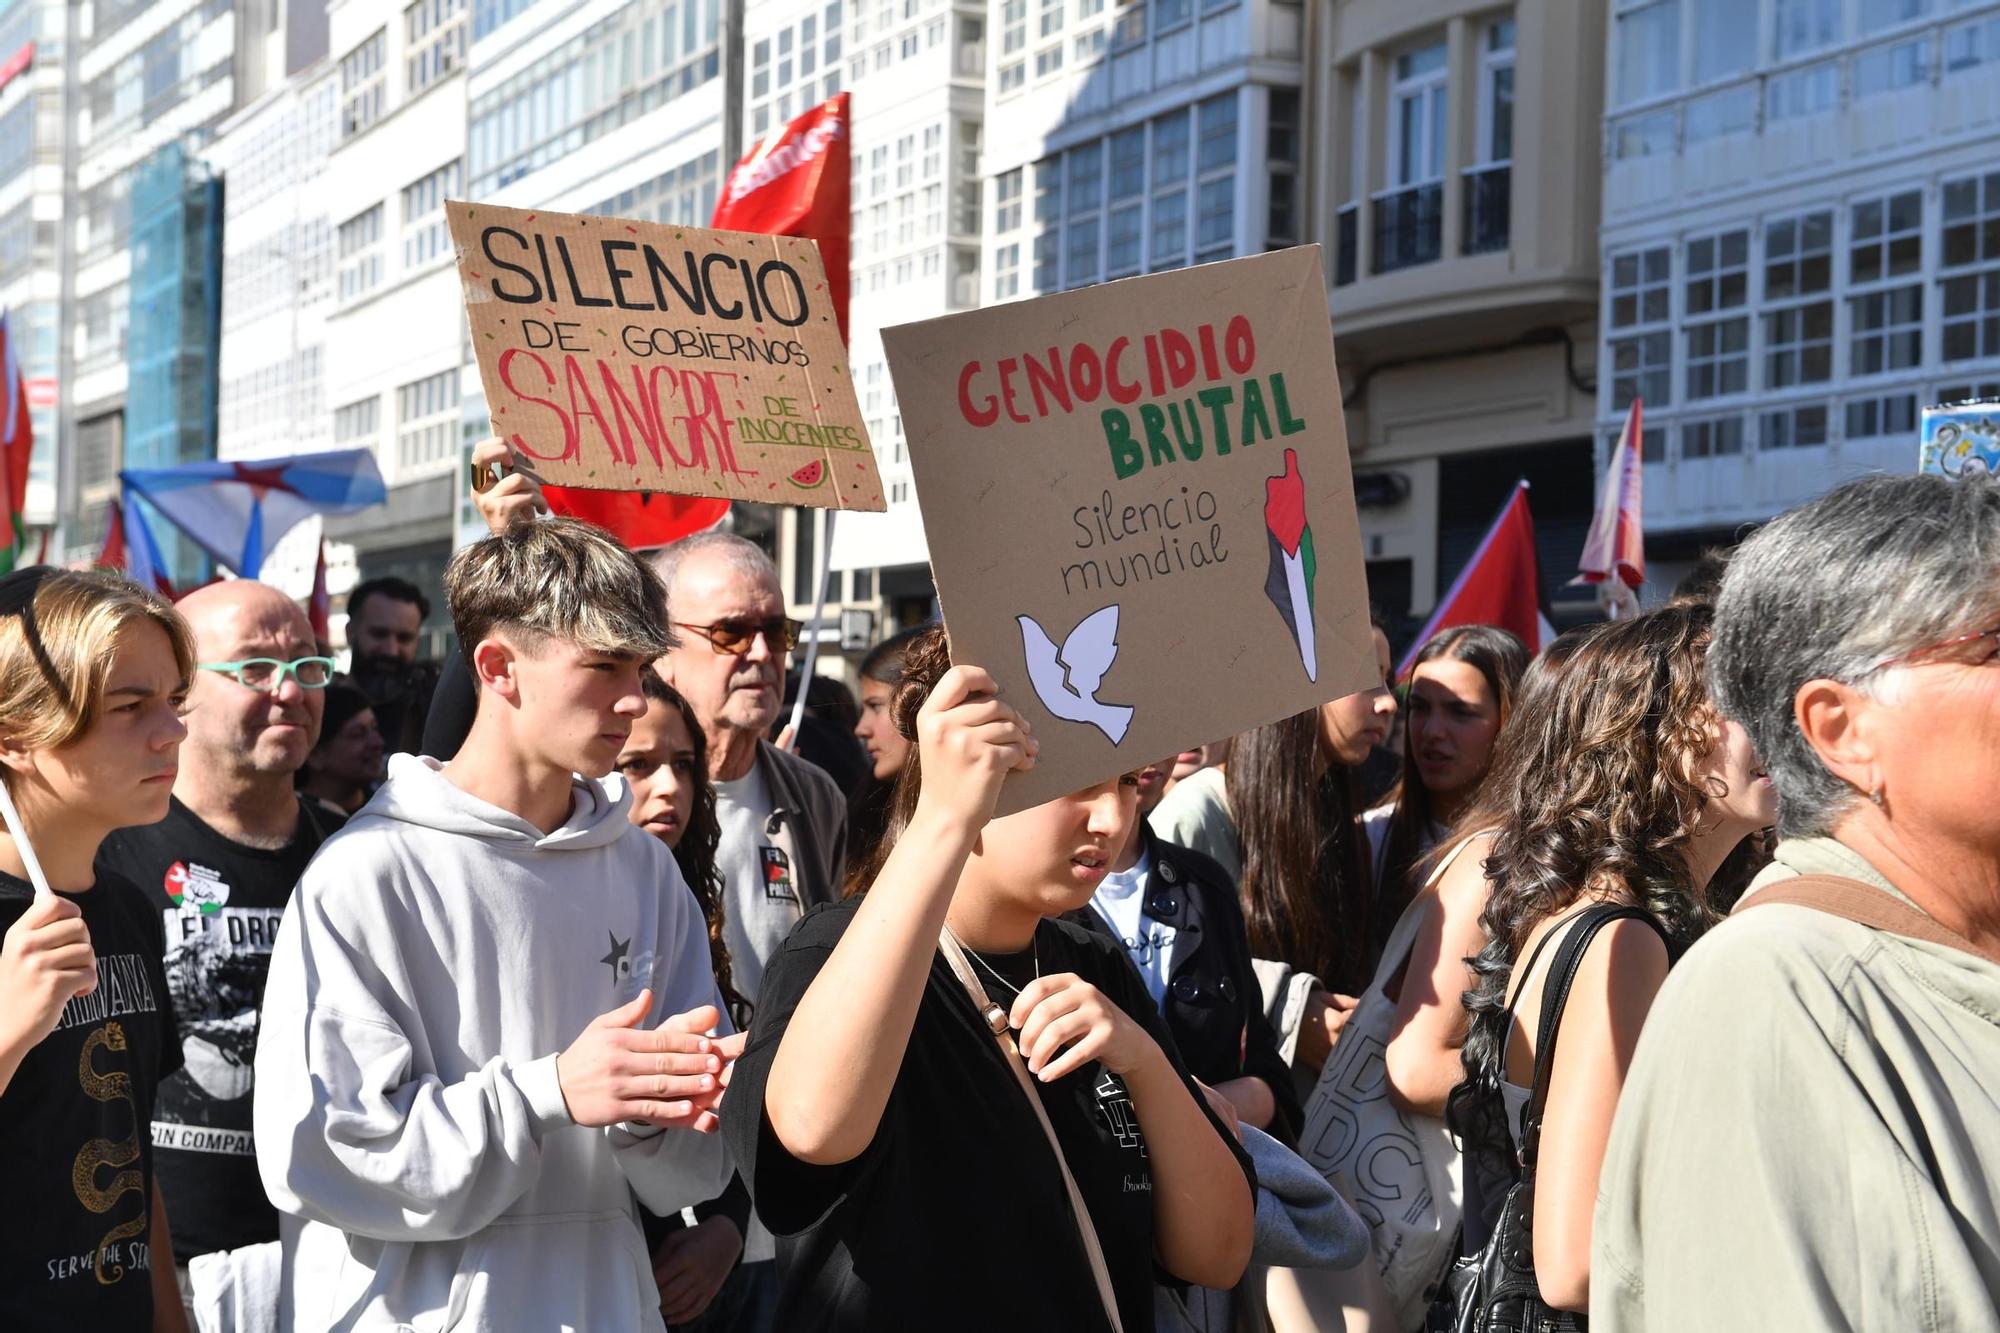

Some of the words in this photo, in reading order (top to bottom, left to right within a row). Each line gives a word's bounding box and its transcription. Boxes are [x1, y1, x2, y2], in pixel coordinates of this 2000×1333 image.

[481, 226, 811, 328] SILENCIO
[521, 319, 590, 353] DE
[958, 314, 1256, 428] GENOCIDIO
[498, 348, 760, 487] SANGRE
[736, 416, 865, 450] INOCENTES
[763, 395, 799, 418] DE
[1101, 372, 1306, 481] BRUTAL
[1060, 523, 1229, 596] mundial
[47, 1249, 96, 1281] SERVE
[101, 1243, 121, 1266] THE
